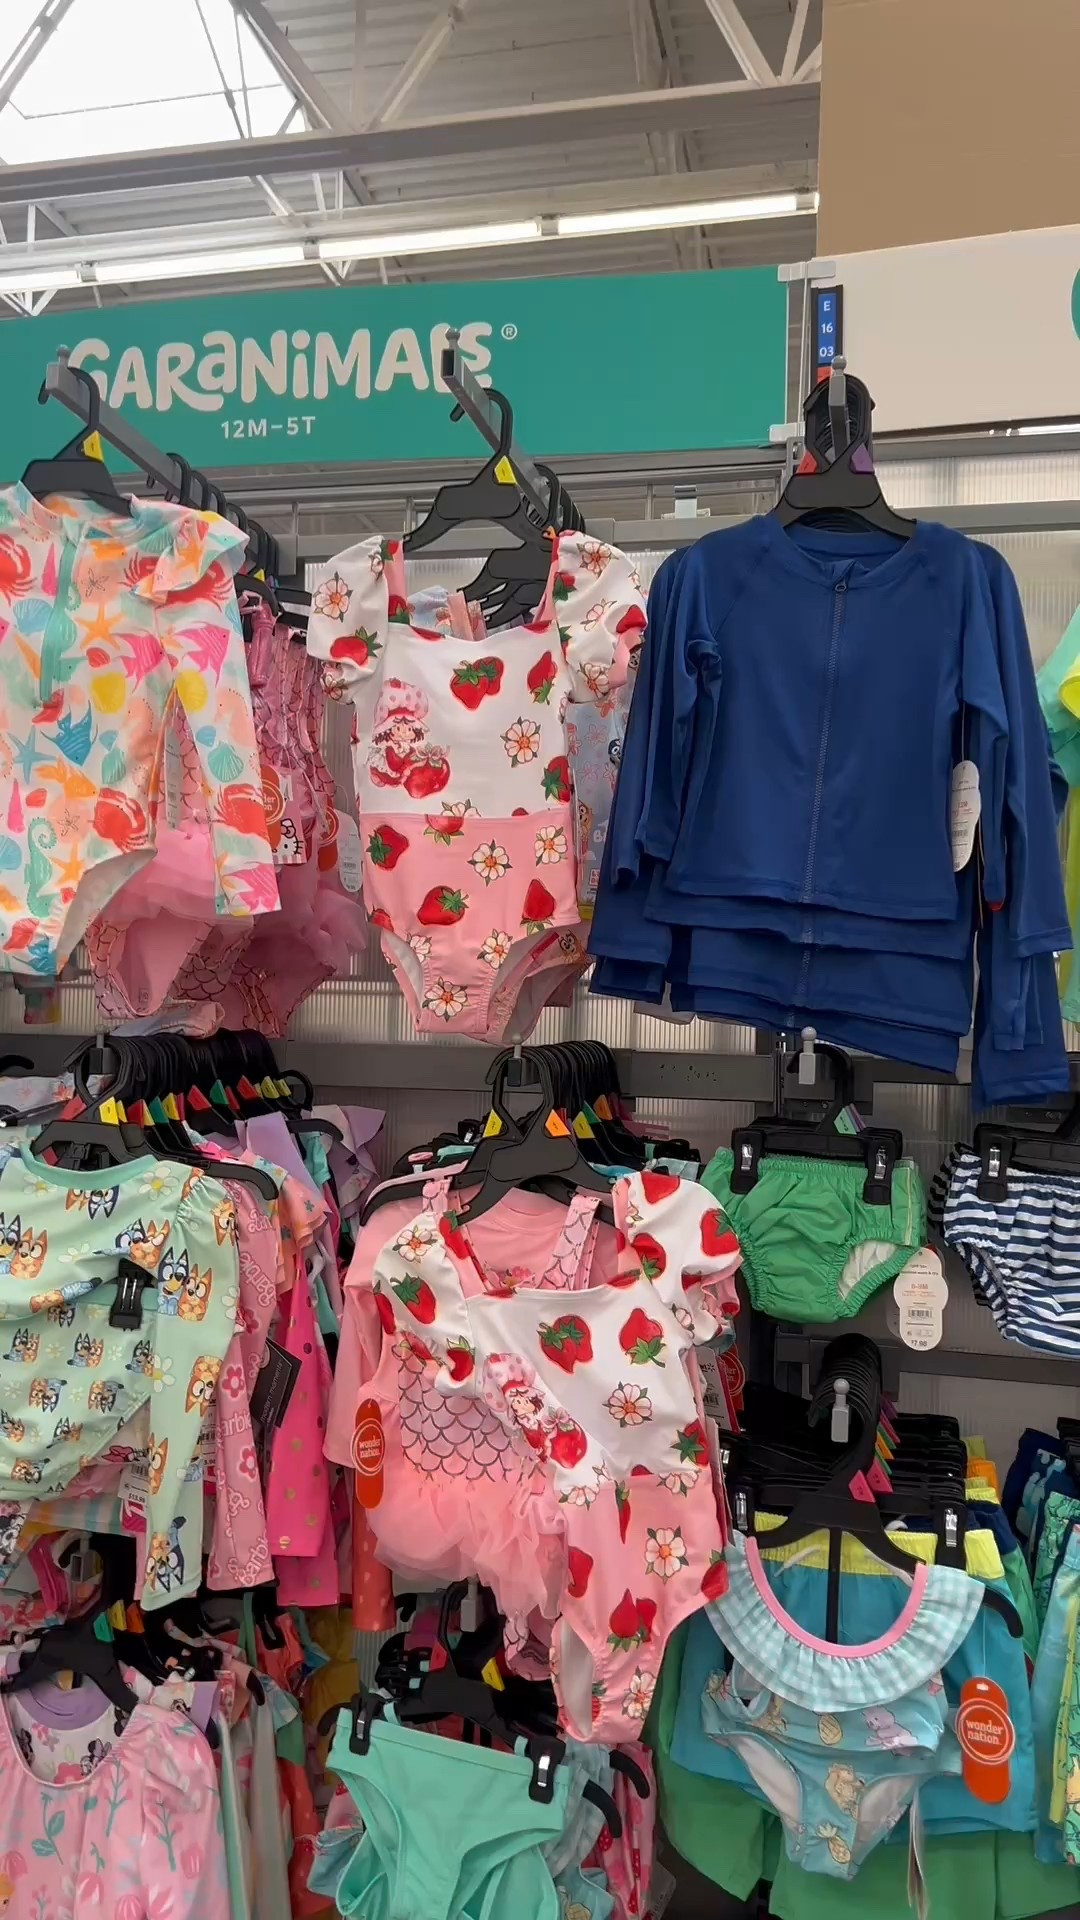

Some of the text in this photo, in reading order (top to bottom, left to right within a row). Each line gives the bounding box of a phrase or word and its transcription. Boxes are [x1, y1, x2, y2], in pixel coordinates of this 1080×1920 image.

[823, 300, 831, 312] E
[821, 323, 834, 333] 16
[819, 346, 834, 358] 03
[965, 1719, 1003, 1735] wonder
